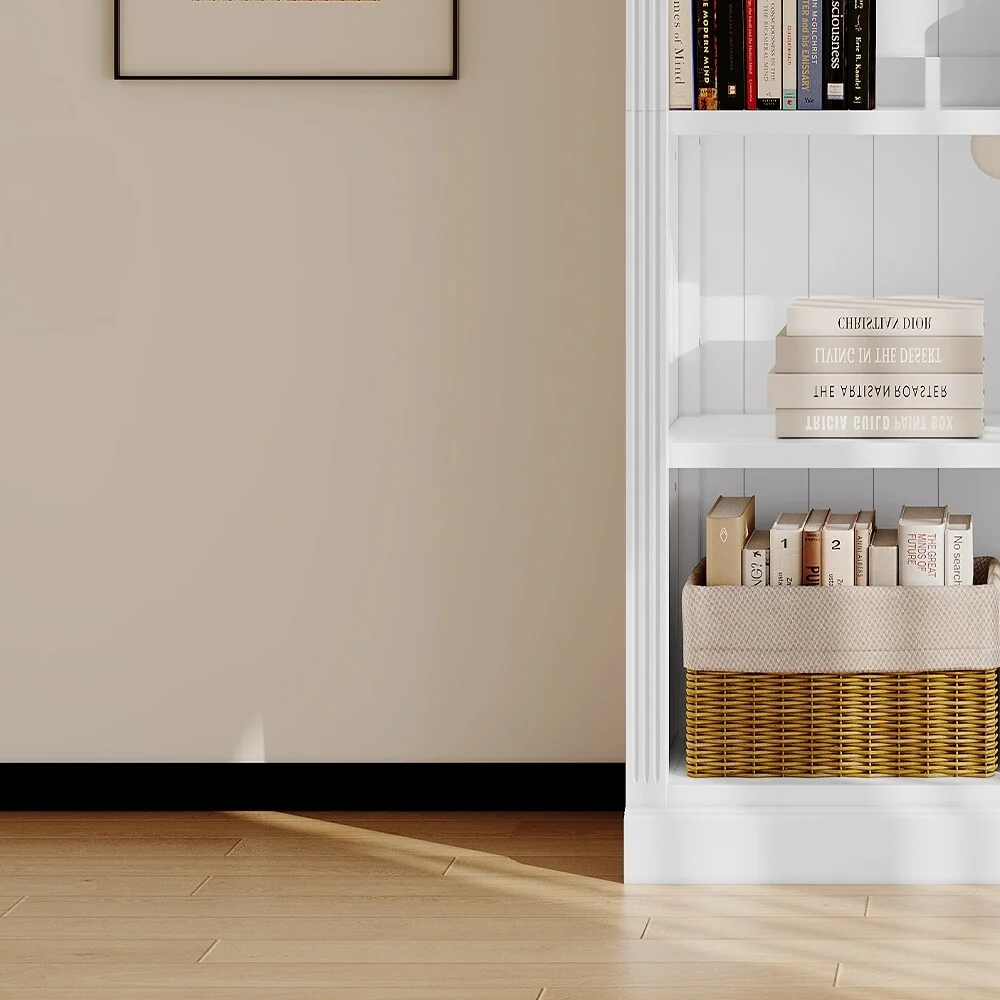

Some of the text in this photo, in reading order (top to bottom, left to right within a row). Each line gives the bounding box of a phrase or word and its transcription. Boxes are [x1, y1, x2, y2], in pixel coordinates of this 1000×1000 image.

[802, 18, 811, 33] and
[674, 32, 683, 44] of
[802, 35, 811, 47] his
[674, 48, 686, 85] Mind
[802, 50, 811, 92] EMISSARY
[781, 538, 788, 549] 1
[832, 540, 841, 550] 2
[908, 534, 917, 565] FUTURE
[954, 536, 963, 551] No
[918, 534, 927, 572] MINDS OF
[928, 534, 937, 578] THE GREAT
